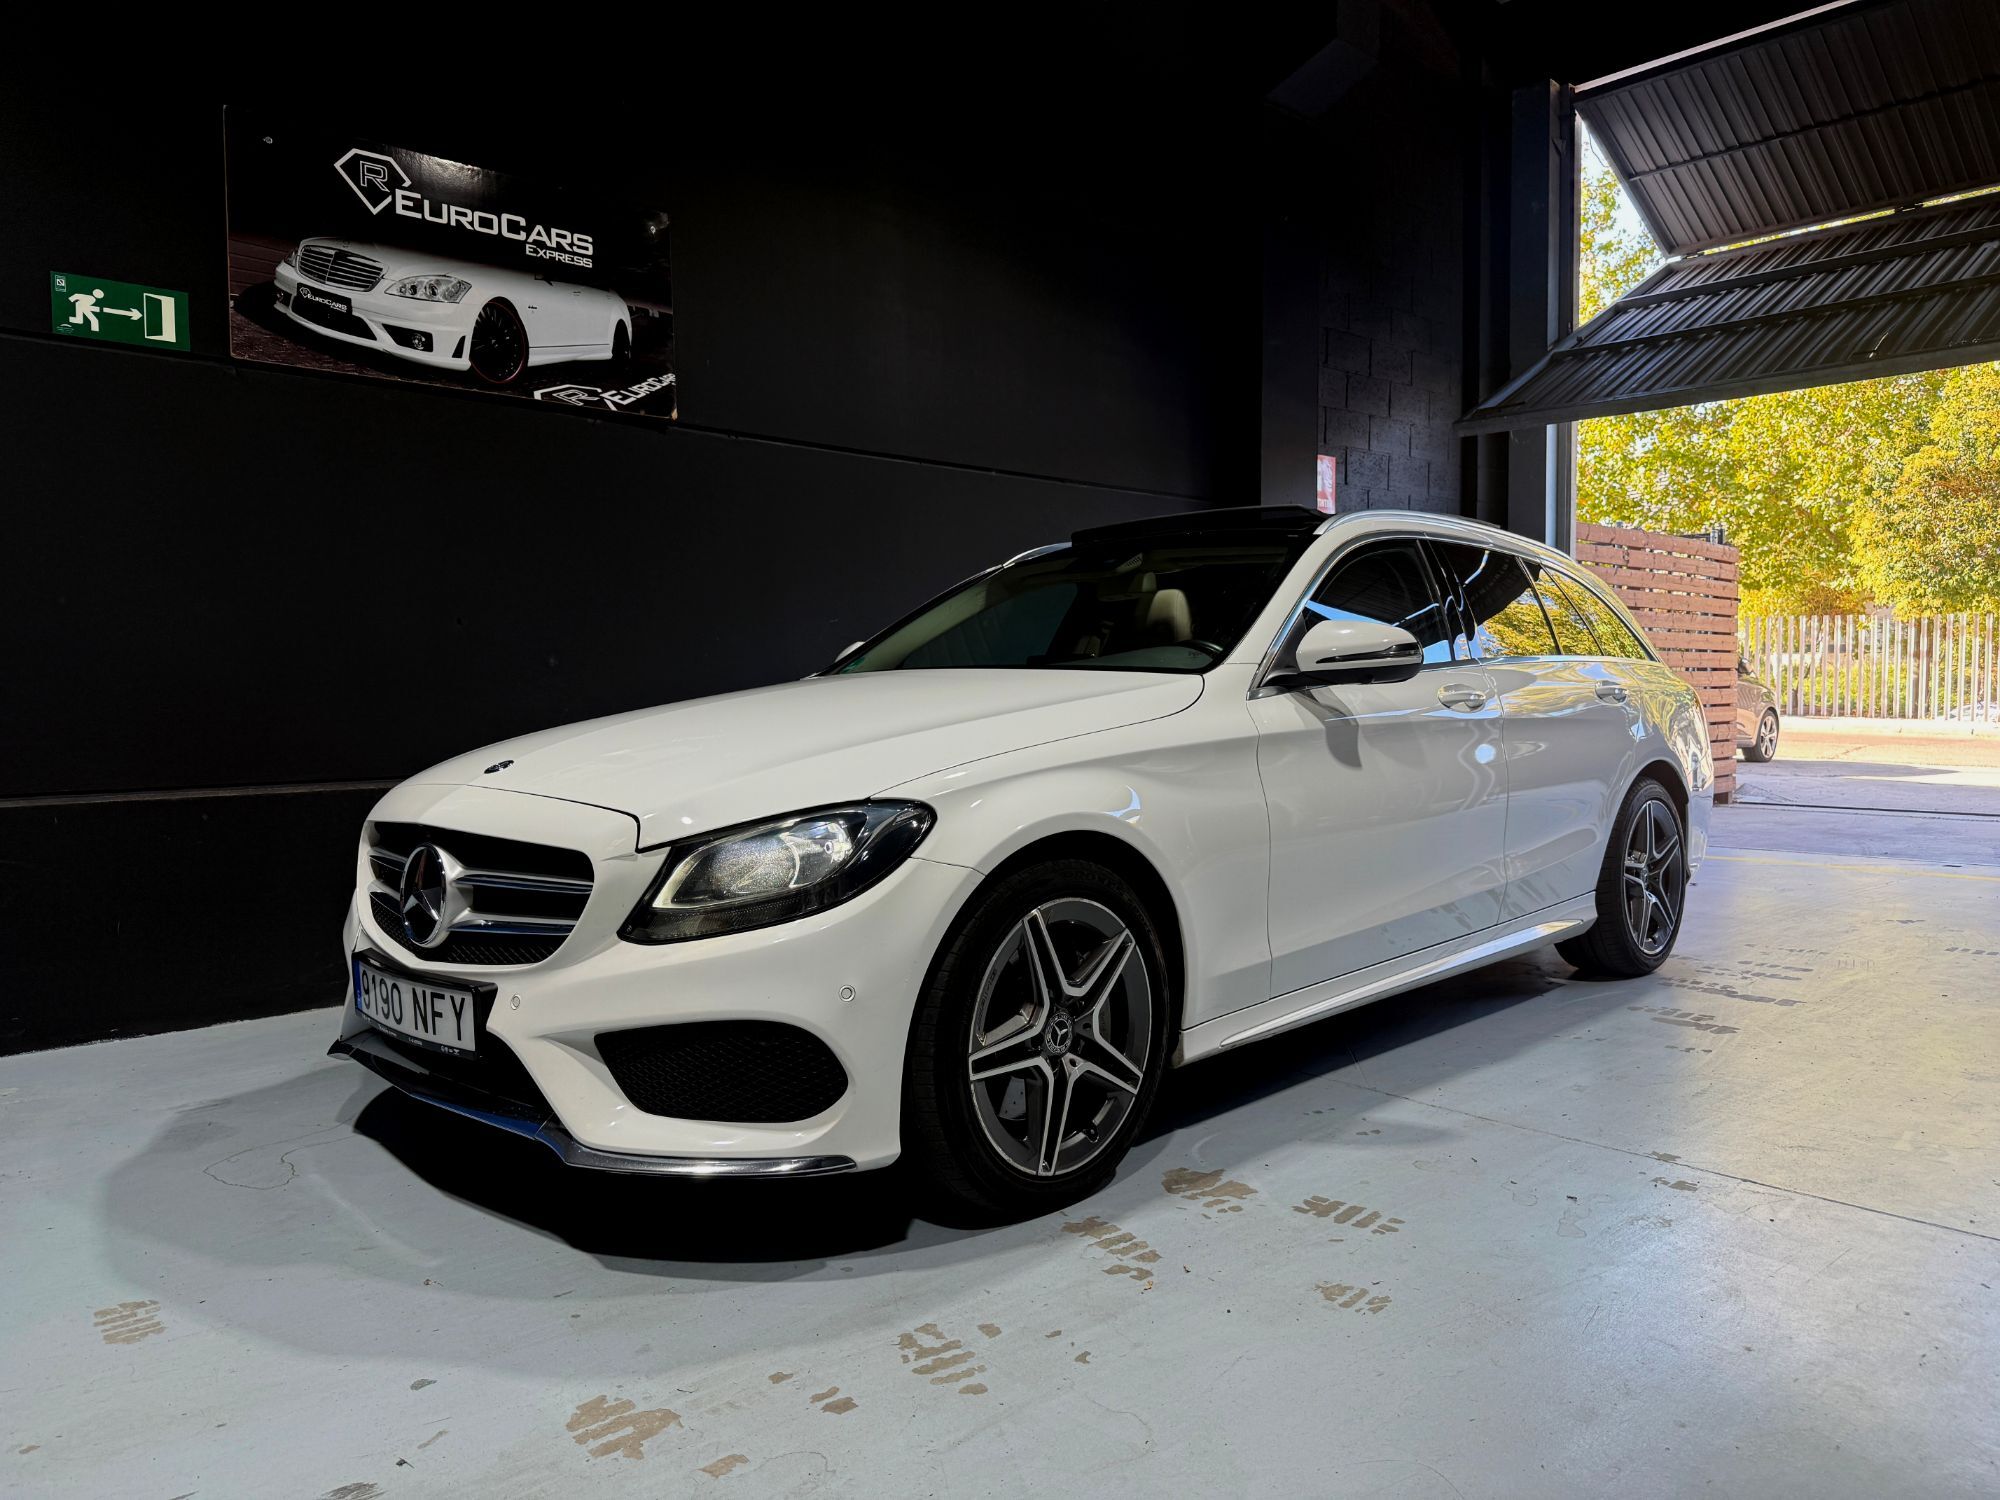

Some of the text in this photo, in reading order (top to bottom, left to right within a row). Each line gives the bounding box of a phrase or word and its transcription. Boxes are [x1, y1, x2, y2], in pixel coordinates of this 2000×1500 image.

[395, 188, 594, 256] EUROCARS
[525, 243, 593, 269] EXPRESS
[361, 969, 466, 1042] 9190 NFY
